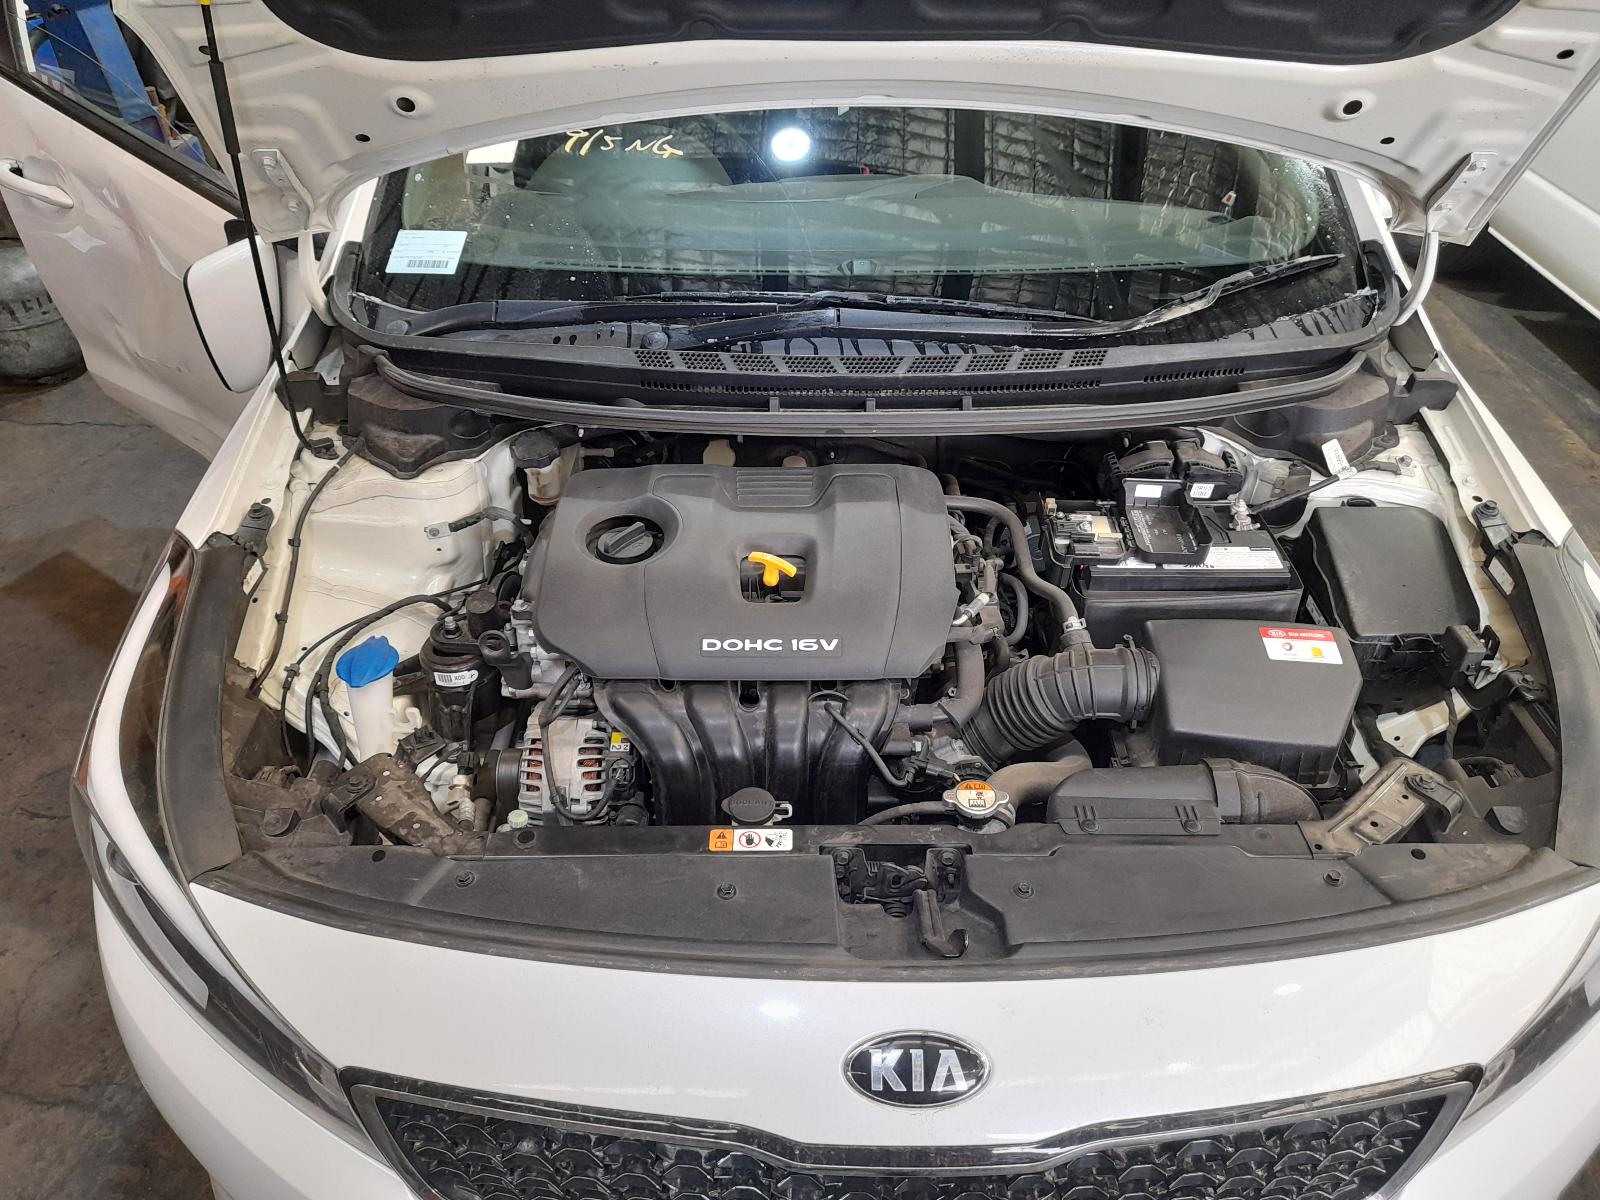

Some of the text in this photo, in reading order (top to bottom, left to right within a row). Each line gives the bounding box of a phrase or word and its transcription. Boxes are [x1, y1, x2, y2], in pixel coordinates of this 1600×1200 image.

[702, 638, 839, 651] DOHC 16V
[868, 1048, 969, 1092] KIA
